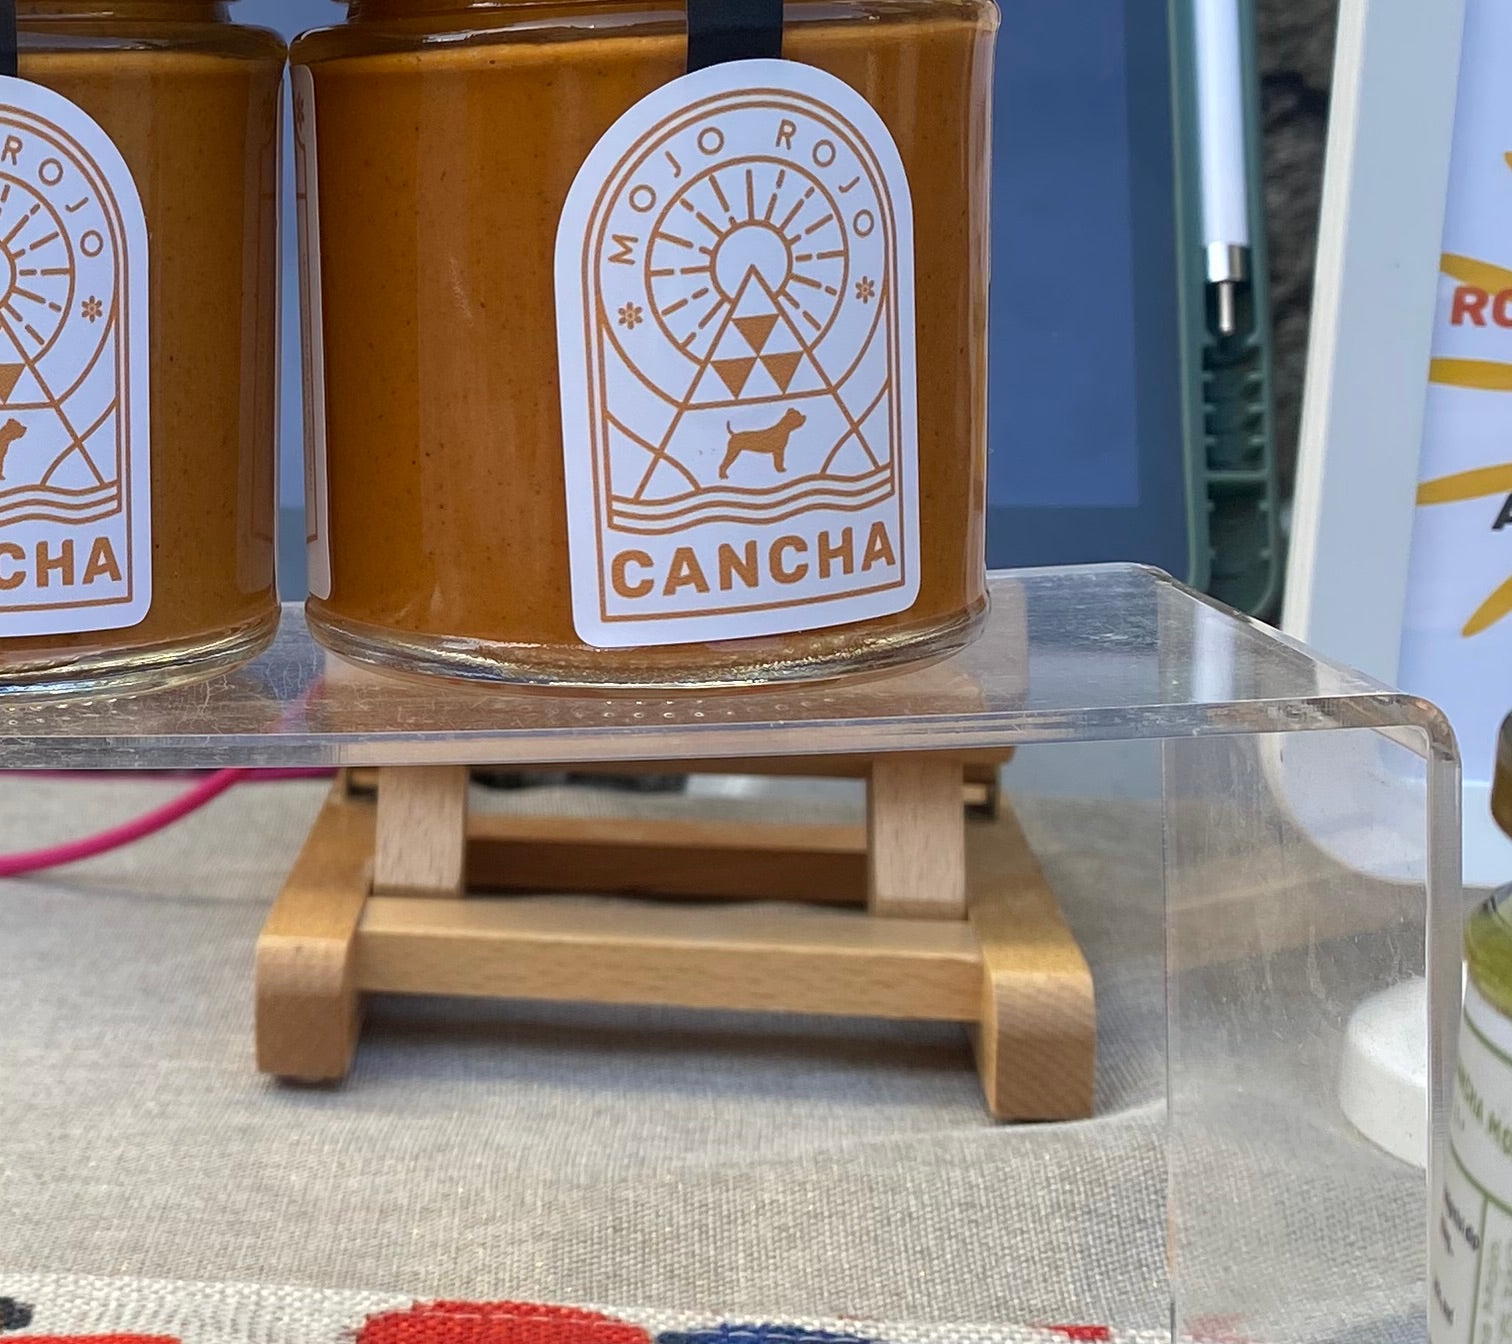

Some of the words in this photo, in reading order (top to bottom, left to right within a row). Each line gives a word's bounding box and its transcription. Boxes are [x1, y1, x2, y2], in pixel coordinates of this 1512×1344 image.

[1, 135, 103, 258] ROJO
[608, 127, 724, 265] MOJO
[775, 118, 875, 238] ROJO
[611, 521, 896, 599] CANCHA
